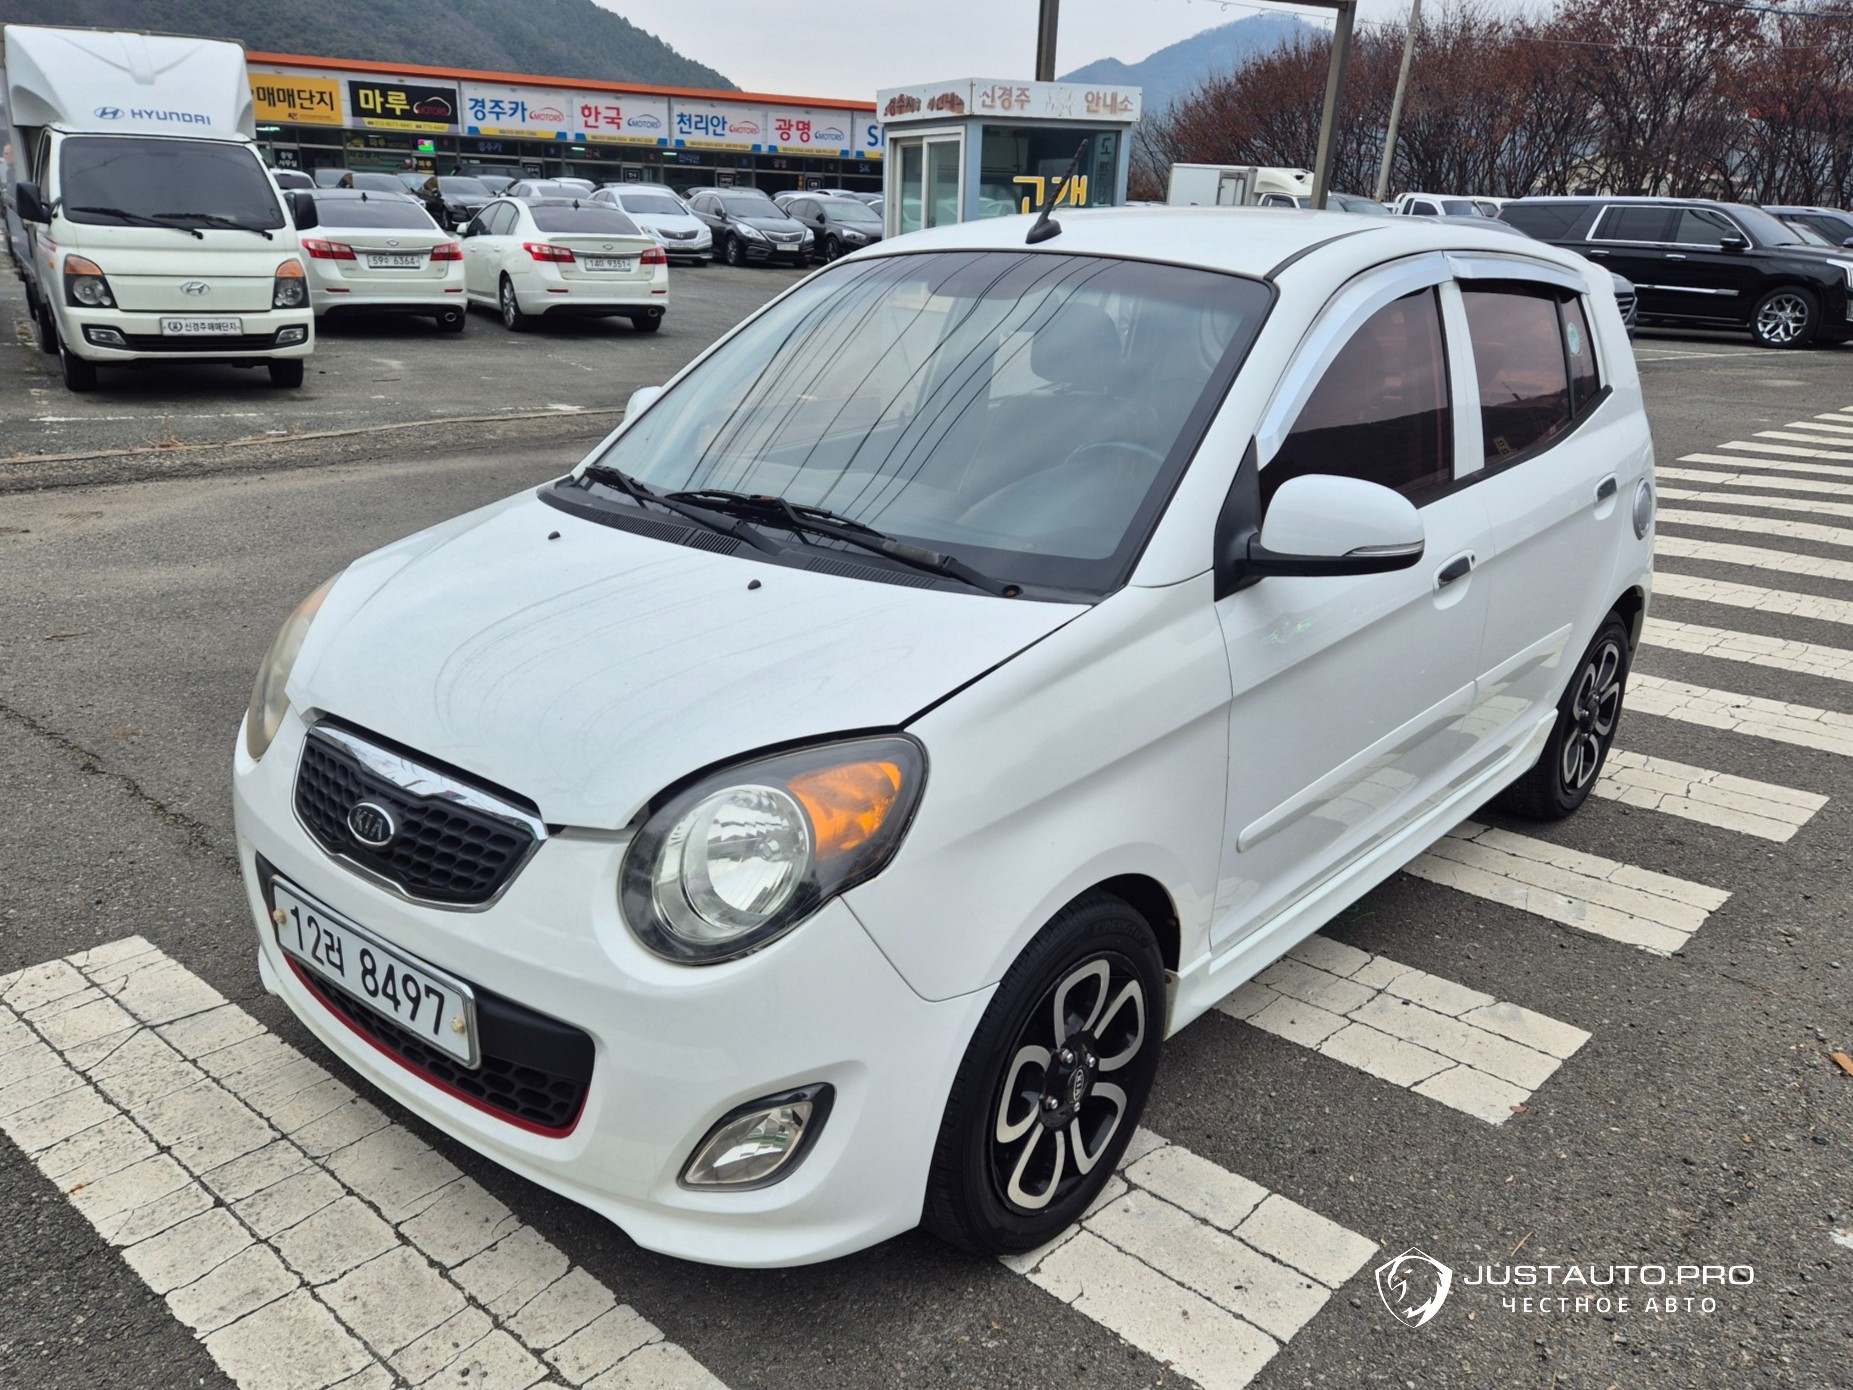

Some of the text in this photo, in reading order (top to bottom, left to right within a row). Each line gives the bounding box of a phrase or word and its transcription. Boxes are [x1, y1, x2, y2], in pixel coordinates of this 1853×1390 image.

[251, 86, 335, 112] 매매단지
[358, 88, 411, 116] 마루
[417, 105, 449, 116] MOTORS
[468, 97, 528, 123] 경주카
[979, 84, 1031, 111] 신경주
[1084, 90, 1134, 115] 안내소
[130, 108, 211, 126] HYUNDAI
[533, 112, 563, 122] MOTORS
[580, 103, 623, 130] 한국
[631, 119, 660, 129] MOTORS
[676, 111, 728, 137] 천리안
[732, 125, 760, 135] MOTORS
[774, 117, 812, 143] 광명
[818, 132, 844, 142] MOTORS
[867, 124, 885, 147] S
[607, 259, 626, 268] 9351
[184, 321, 237, 332] 신경주매매단지
[358, 946, 445, 1036] 8497
